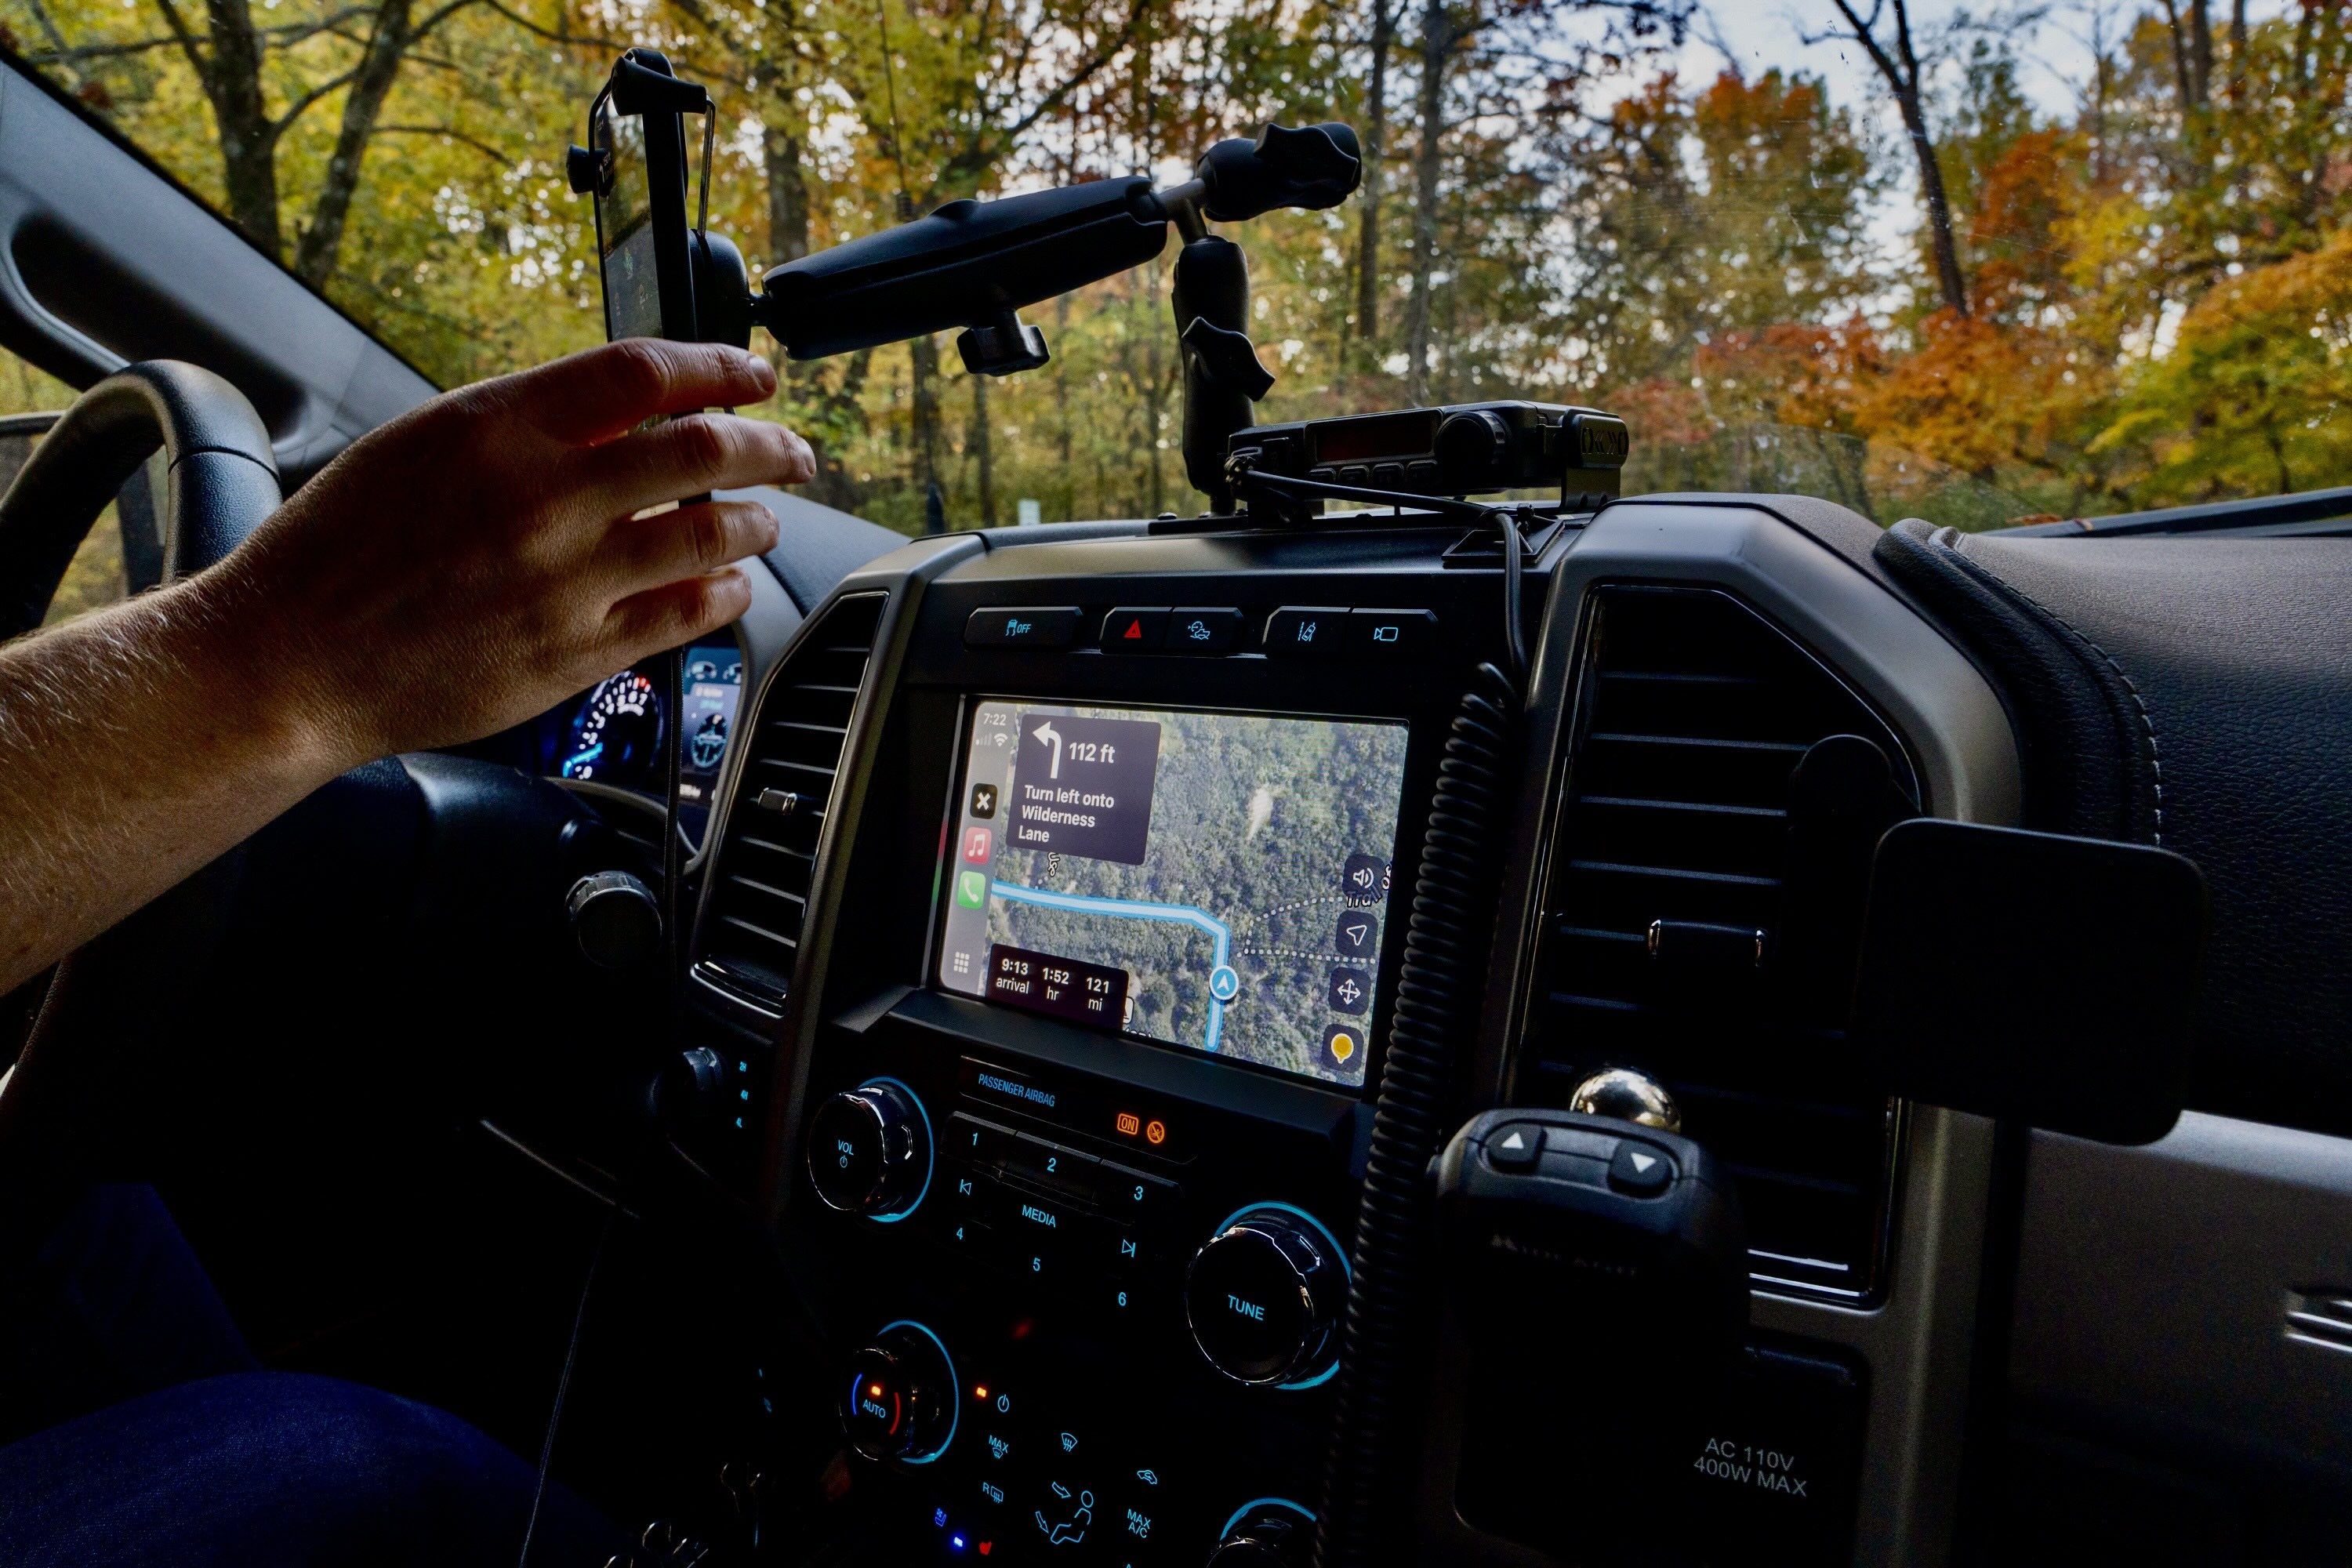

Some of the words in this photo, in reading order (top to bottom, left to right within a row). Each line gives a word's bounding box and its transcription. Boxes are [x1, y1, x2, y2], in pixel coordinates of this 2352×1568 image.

[1016, 623, 1032, 633] OFF
[983, 713, 1007, 726] 7:22
[1069, 742, 1096, 762] 112
[1100, 744, 1116, 764] ft
[1025, 785, 1054, 801] Turn
[1056, 788, 1080, 805] left
[1083, 793, 1115, 808] onto
[1022, 805, 1096, 828] Wilderness
[1018, 825, 1050, 843] Lane
[1047, 851, 1060, 877] Use
[1001, 957, 1029, 975] 9:13
[1042, 967, 1069, 985] 1:52
[1086, 977, 1109, 994] 121
[996, 976, 1029, 995] arrival
[1047, 985, 1059, 1001] hr
[1088, 997, 1102, 1011] mi
[978, 1072, 1025, 1098] PASSENGER
[1025, 1087, 1055, 1107] AIRBAG
[1121, 1117, 1135, 1131] ON
[838, 1139, 854, 1156] VOL
[972, 1133, 978, 1145] 1
[1047, 1157, 1057, 1172] 2
[1134, 1185, 1144, 1201] 3
[1022, 1204, 1056, 1228] MEDIA
[956, 1227, 964, 1240] 4
[1033, 1257, 1041, 1272] 5
[1118, 1291, 1127, 1307] 6
[1228, 1294, 1265, 1321] TUNE
[862, 1399, 886, 1418] AUTO
[989, 1435, 1009, 1454] MAX
[1704, 1438, 1735, 1458] AC
[1744, 1446, 1795, 1472] 110V
[1693, 1456, 1751, 1483] 400W
[1758, 1470, 1806, 1497] MAX
[982, 1482, 989, 1494] R
[1127, 1508, 1151, 1530] MAX
[1128, 1522, 1148, 1538] A/C
